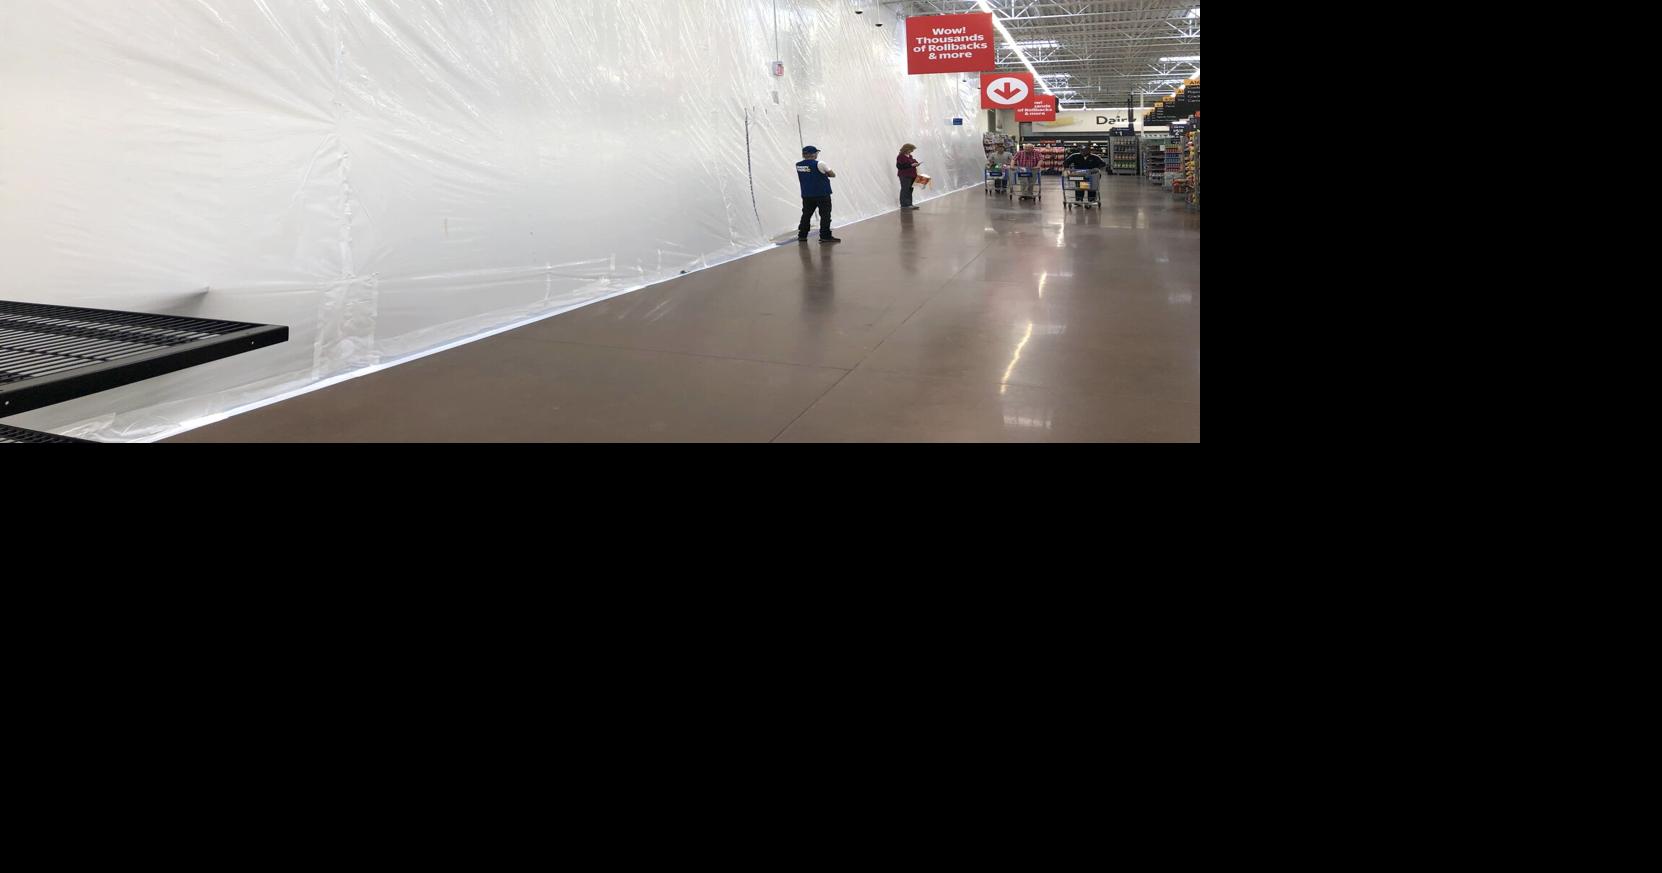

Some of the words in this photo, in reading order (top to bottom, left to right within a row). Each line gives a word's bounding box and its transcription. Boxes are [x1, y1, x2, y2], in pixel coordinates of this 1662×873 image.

[932, 27, 966, 36] Wow!
[916, 34, 984, 44] Thousands
[928, 42, 988, 52] Rollbacks
